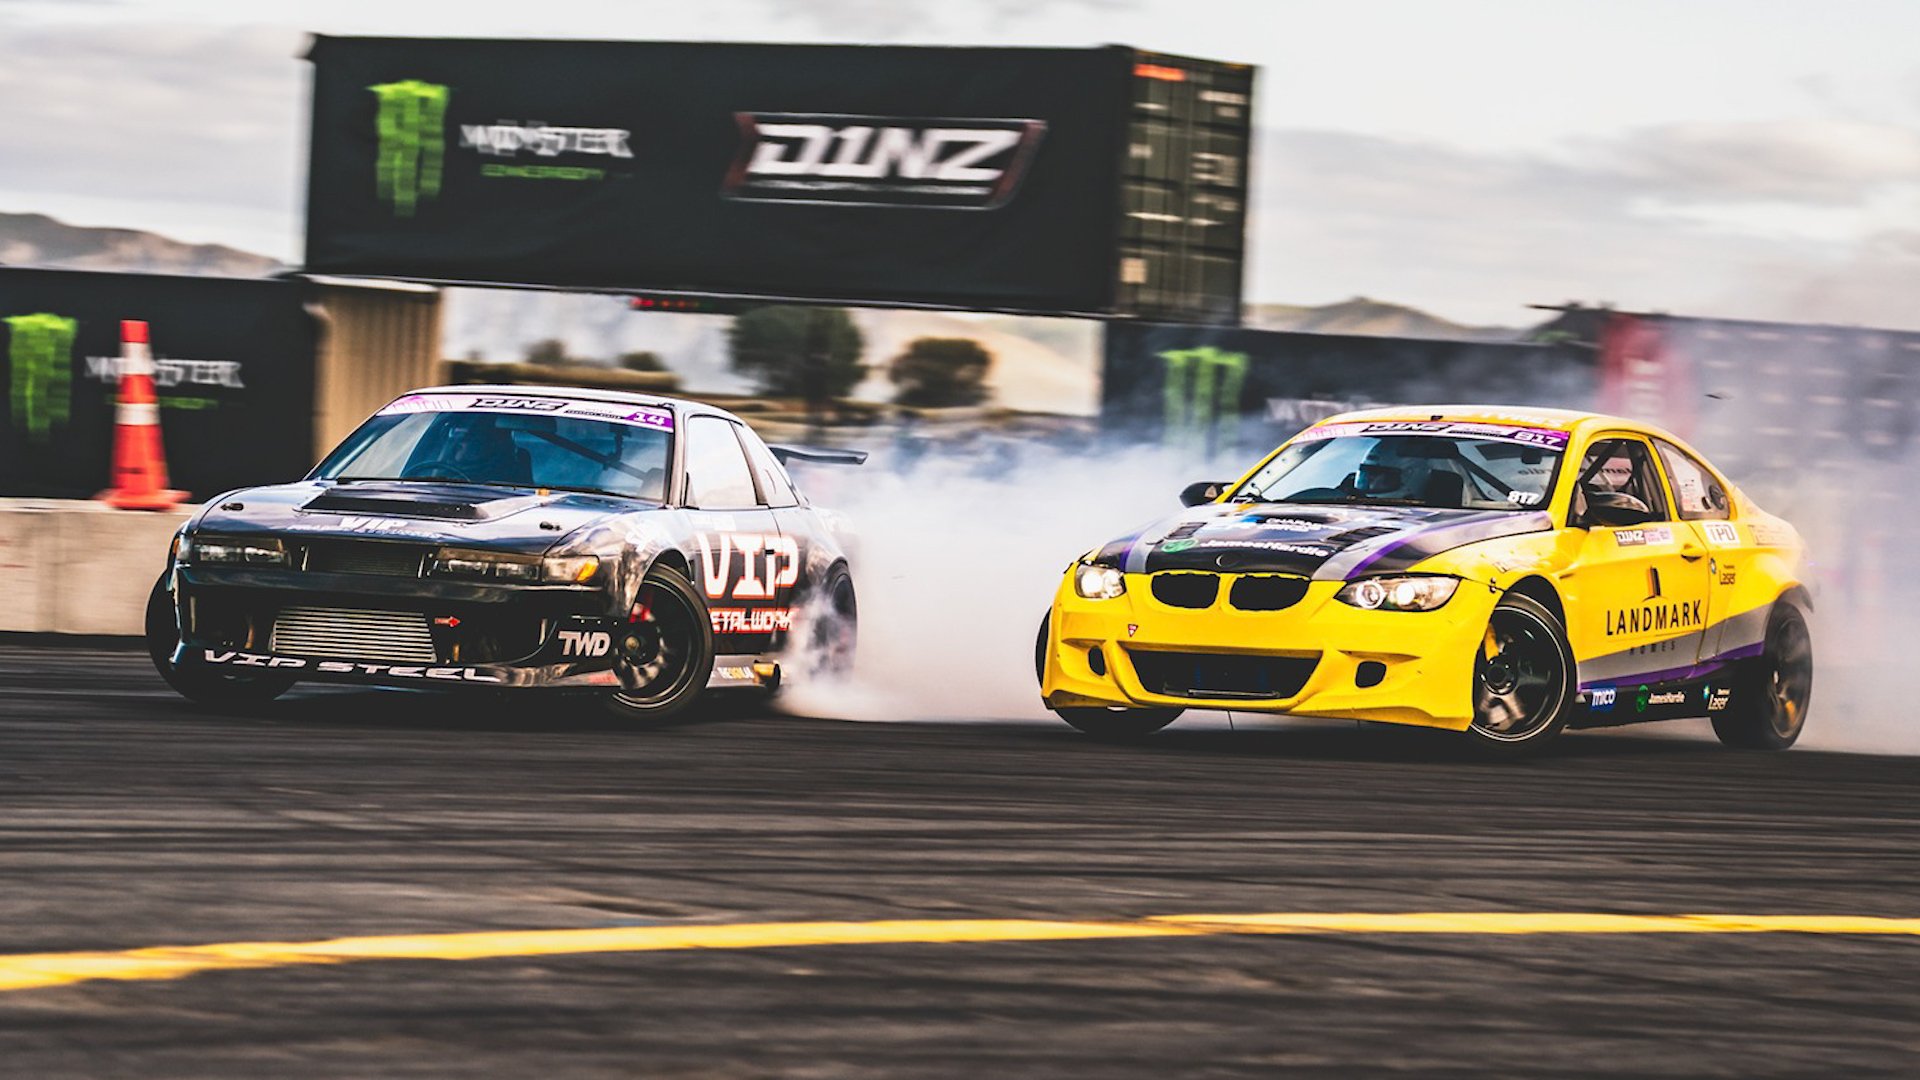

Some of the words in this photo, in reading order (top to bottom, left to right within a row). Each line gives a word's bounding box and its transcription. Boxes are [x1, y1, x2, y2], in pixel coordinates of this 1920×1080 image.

[746, 123, 1022, 181] D1NZ
[633, 413, 665, 426] 14
[1515, 431, 1562, 445] 817
[1507, 490, 1539, 505] 817
[340, 516, 408, 530] VIP
[696, 533, 799, 598] VIP
[1606, 600, 1702, 636] LANDMARK
[558, 630, 611, 656] TWD
[204, 649, 306, 667] VIP
[317, 661, 502, 682] STEEL
[1591, 690, 1616, 707] mico
